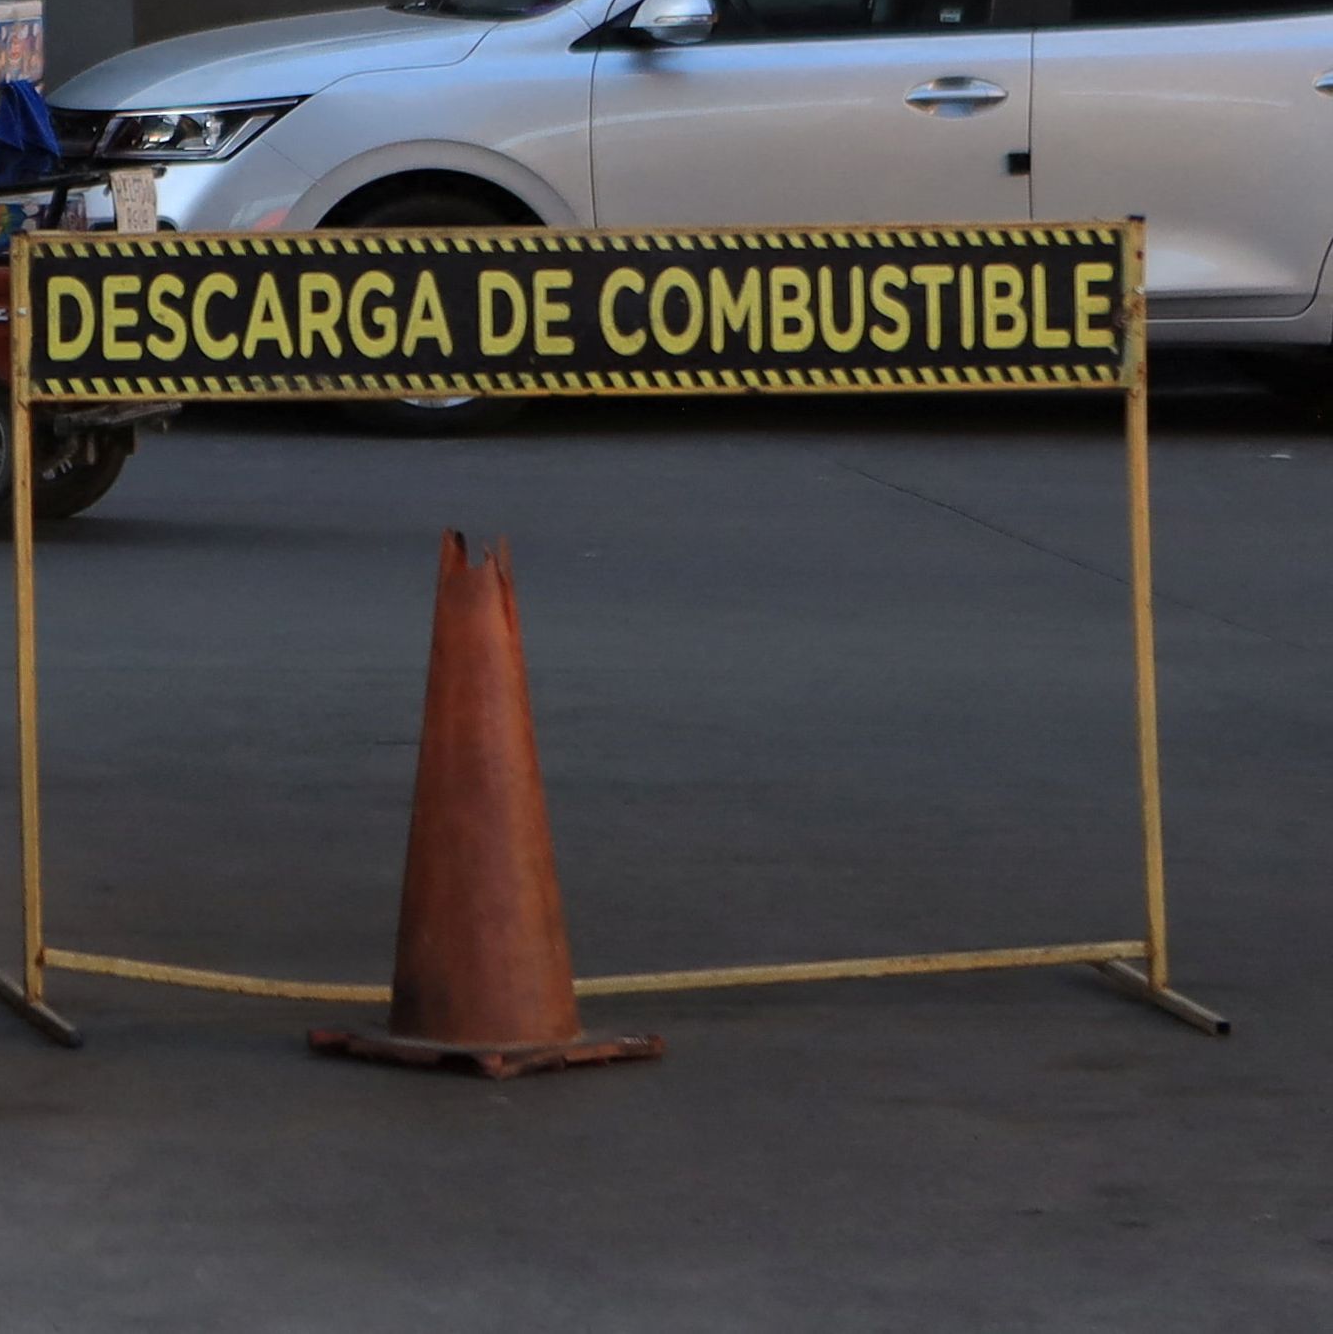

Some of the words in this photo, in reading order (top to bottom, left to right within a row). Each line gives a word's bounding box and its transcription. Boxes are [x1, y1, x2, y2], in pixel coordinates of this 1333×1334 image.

[46, 269, 454, 362] DESCARGA
[477, 268, 576, 358] DE
[598, 262, 1116, 356] COMBUSTIBLE
